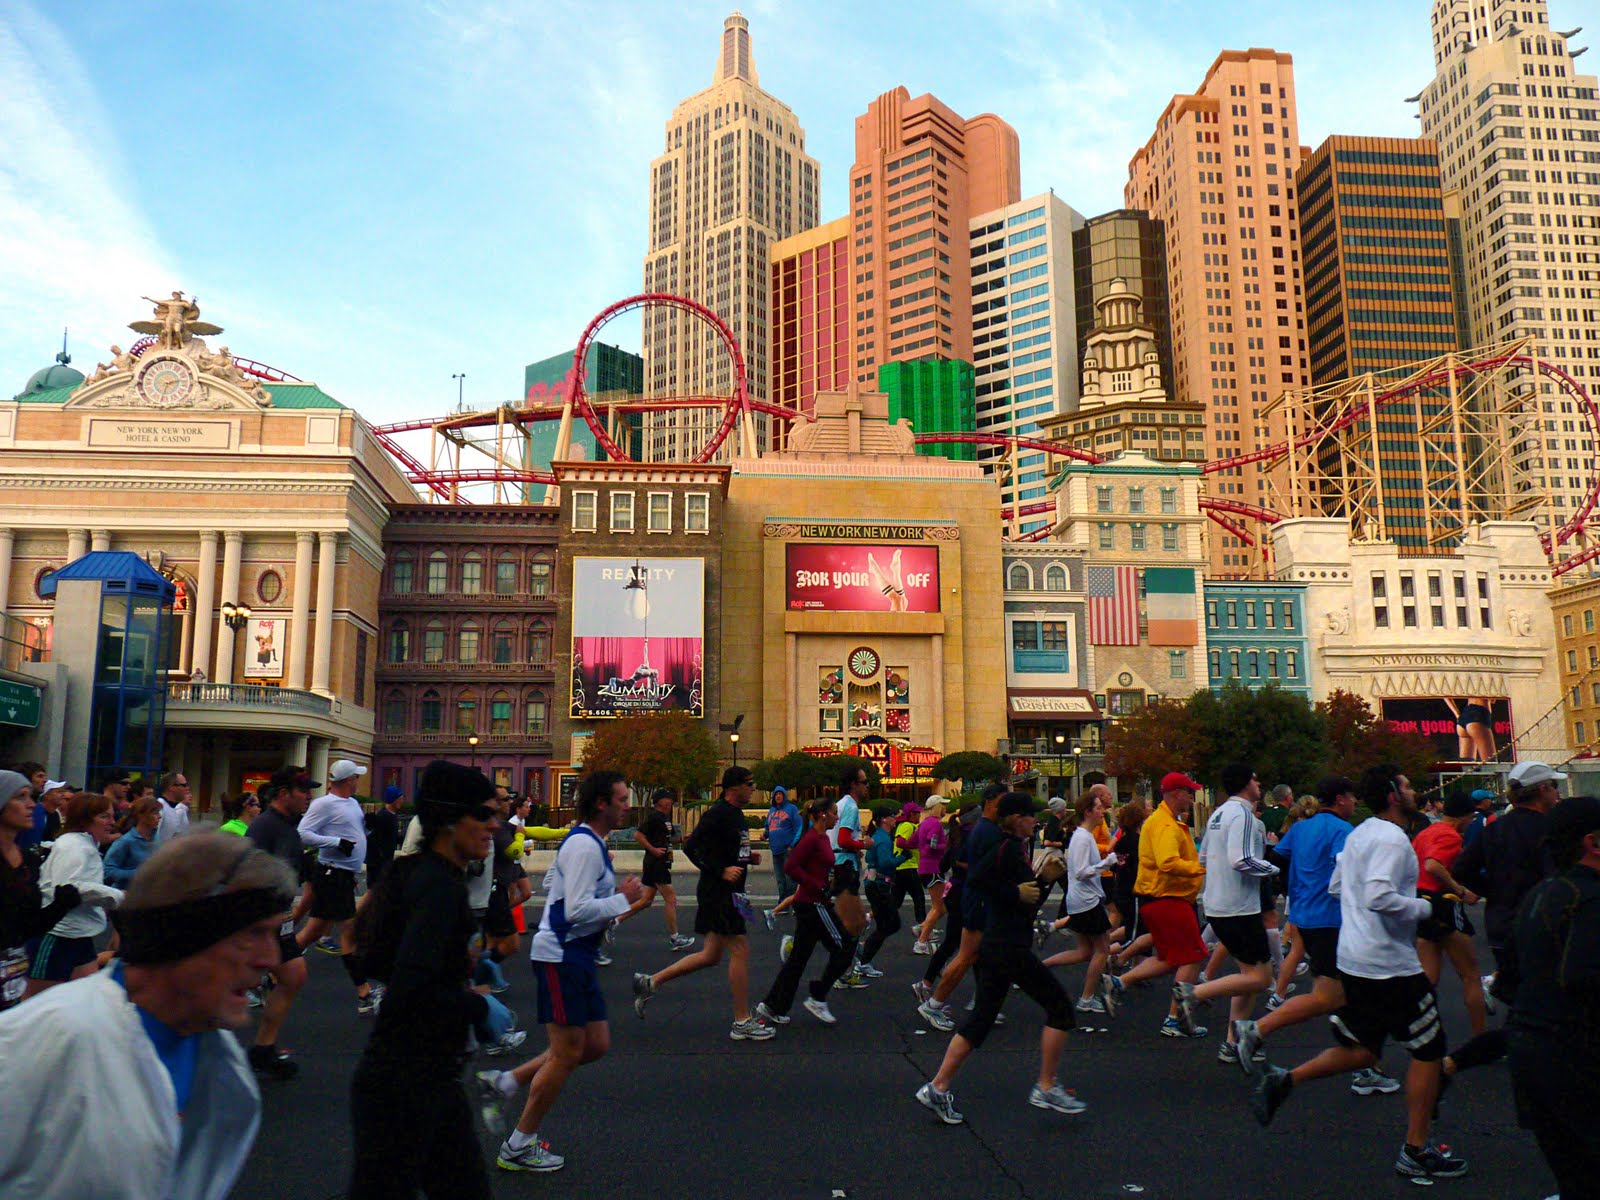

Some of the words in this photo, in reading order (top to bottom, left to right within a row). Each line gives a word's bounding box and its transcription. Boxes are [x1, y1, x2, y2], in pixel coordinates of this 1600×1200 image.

[161, 427, 180, 435] NEW
[126, 434, 150, 442] HOTEL
[602, 568, 675, 580] REALITY
[1372, 655, 1401, 666] NEW
[1406, 655, 1442, 665] YORK
[1444, 655, 1471, 665] NEW
[1473, 656, 1503, 666] YORK
[860, 743, 888, 758] NY
